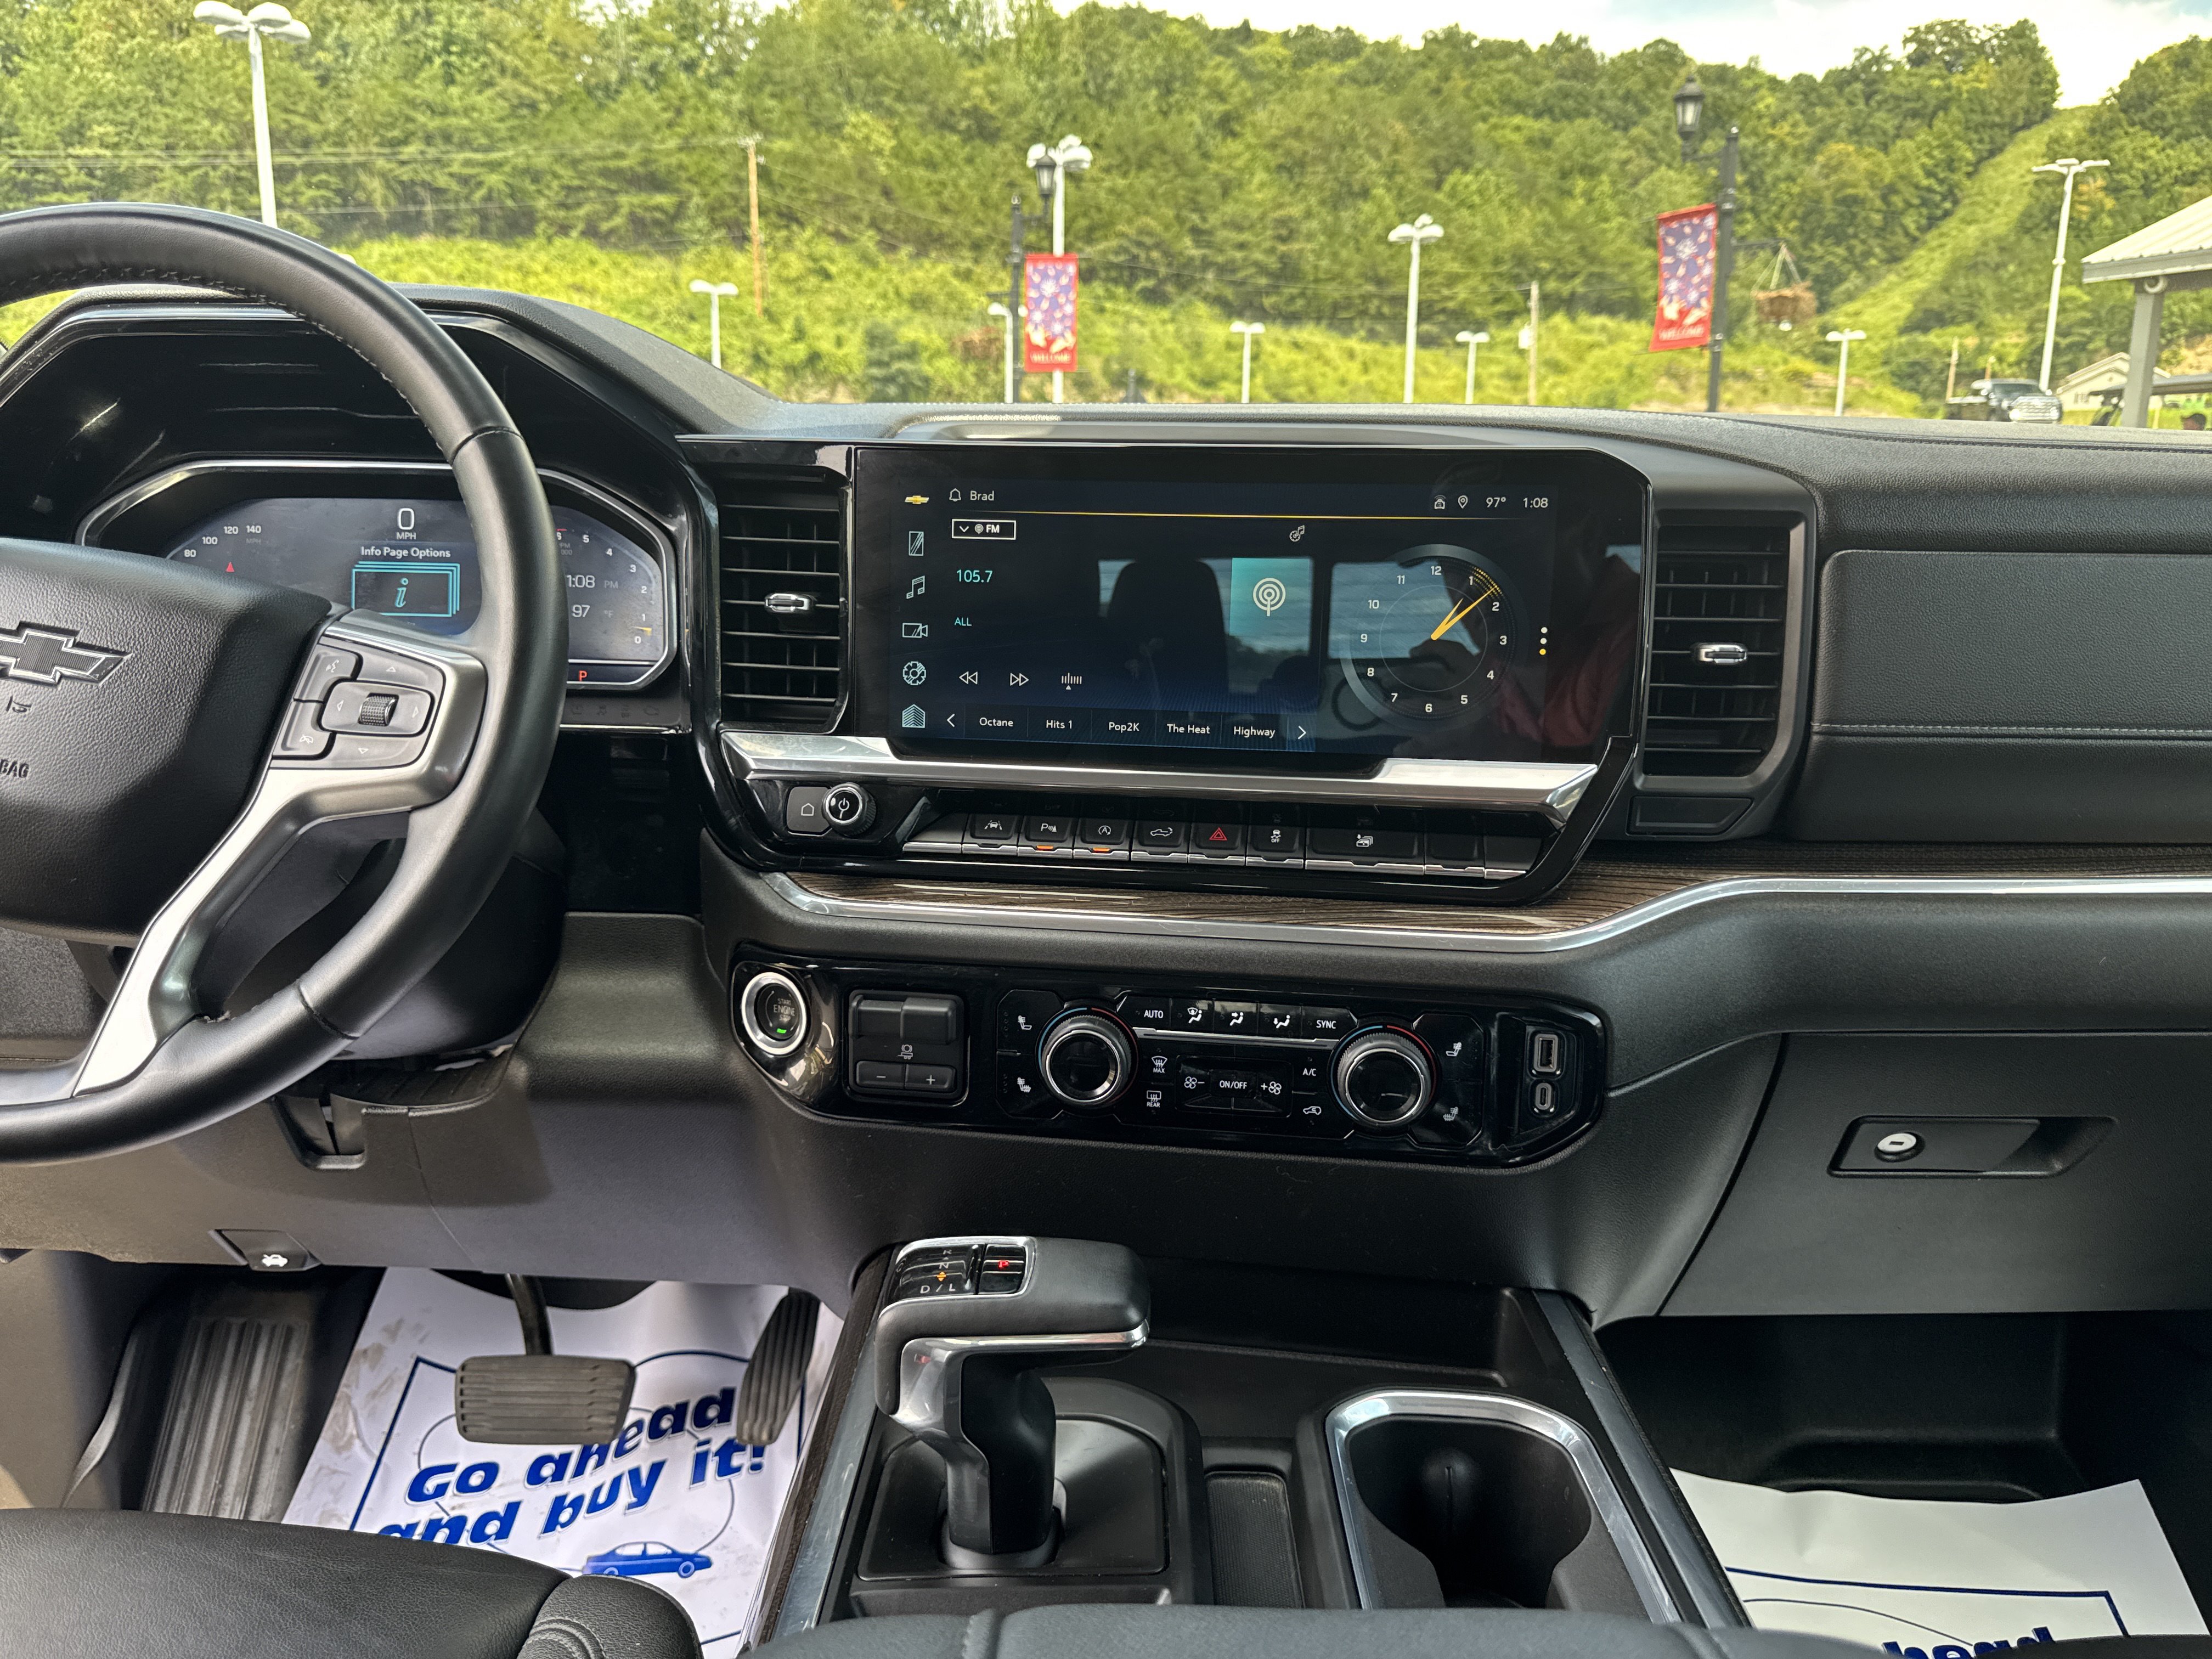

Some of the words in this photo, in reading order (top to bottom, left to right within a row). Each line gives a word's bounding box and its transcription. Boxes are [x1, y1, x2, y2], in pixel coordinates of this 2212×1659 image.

[970, 490, 995, 501] Brad
[1486, 496, 1506, 508] 97°
[1523, 497, 1548, 508] 1:08
[398, 508, 415, 530] 0
[223, 526, 239, 534] 120
[986, 524, 1000, 533] FM
[202, 537, 218, 545] 100
[396, 532, 416, 540] MPH
[583, 534, 590, 543] 5
[184, 549, 196, 557] 80
[361, 546, 381, 556] Info
[384, 547, 408, 559] Page
[411, 548, 451, 559] Options
[606, 548, 613, 556] 4
[1430, 566, 1442, 575] 12
[956, 569, 993, 583] 105.7
[1397, 575, 1405, 584] 11
[1469, 576, 1474, 585] 1
[567, 575, 595, 588] 1:08
[604, 580, 618, 589] PM
[1368, 600, 1379, 609] 10
[1492, 602, 1499, 611] 2
[572, 604, 590, 618] 97
[954, 617, 972, 627] ALL
[634, 636, 641, 644] 0
[1360, 634, 1368, 643] 9
[1499, 635, 1507, 645] 3
[579, 670, 588, 681] P
[1367, 668, 1374, 677] 8
[1487, 670, 1494, 680] 4
[1391, 693, 1398, 702] 7
[1460, 695, 1468, 704] 5
[1425, 703, 1432, 713] 6
[979, 717, 1014, 727] Octane
[1046, 719, 1064, 730] Hits
[1068, 720, 1073, 729] 1
[1108, 721, 1140, 733] Pop2K
[1166, 724, 1185, 734] The
[1187, 724, 1210, 734] Heat
[1233, 725, 1276, 739] Highway
[773, 1004, 795, 1017] ENGINE
[1144, 1009, 1164, 1019] AUTO
[1316, 1020, 1336, 1029] SYNC
[1302, 1068, 1317, 1076] A/C
[1219, 1080, 1248, 1090] ON/OFF
[998, 1260, 1009, 1269] P
[404, 1461, 500, 1505] Go
[524, 1386, 736, 1488] ahead
[540, 1459, 668, 1539] buy
